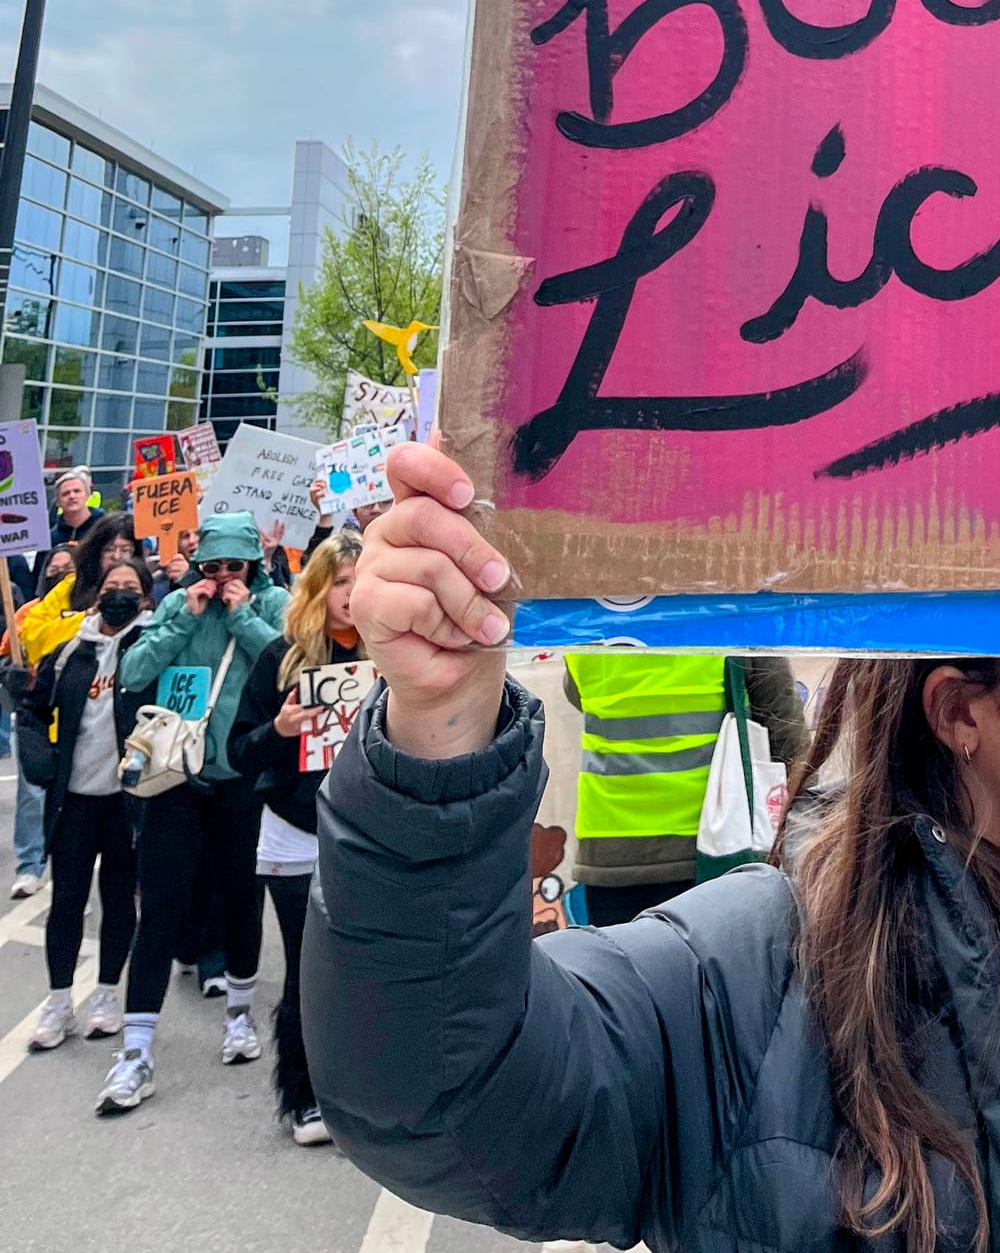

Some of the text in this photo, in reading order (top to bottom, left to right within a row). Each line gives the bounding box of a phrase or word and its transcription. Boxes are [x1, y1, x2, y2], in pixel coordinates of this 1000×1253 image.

[257, 448, 299, 466] ABOLISH
[251, 466, 285, 481] FREE
[136, 477, 193, 503] FUERA
[232, 484, 273, 500] STAND
[281, 492, 308, 506] WITH
[152, 498, 180, 518] ICE
[272, 501, 317, 521] SCIENCE
[170, 672, 197, 694] ICE
[167, 694, 197, 714] OUT
